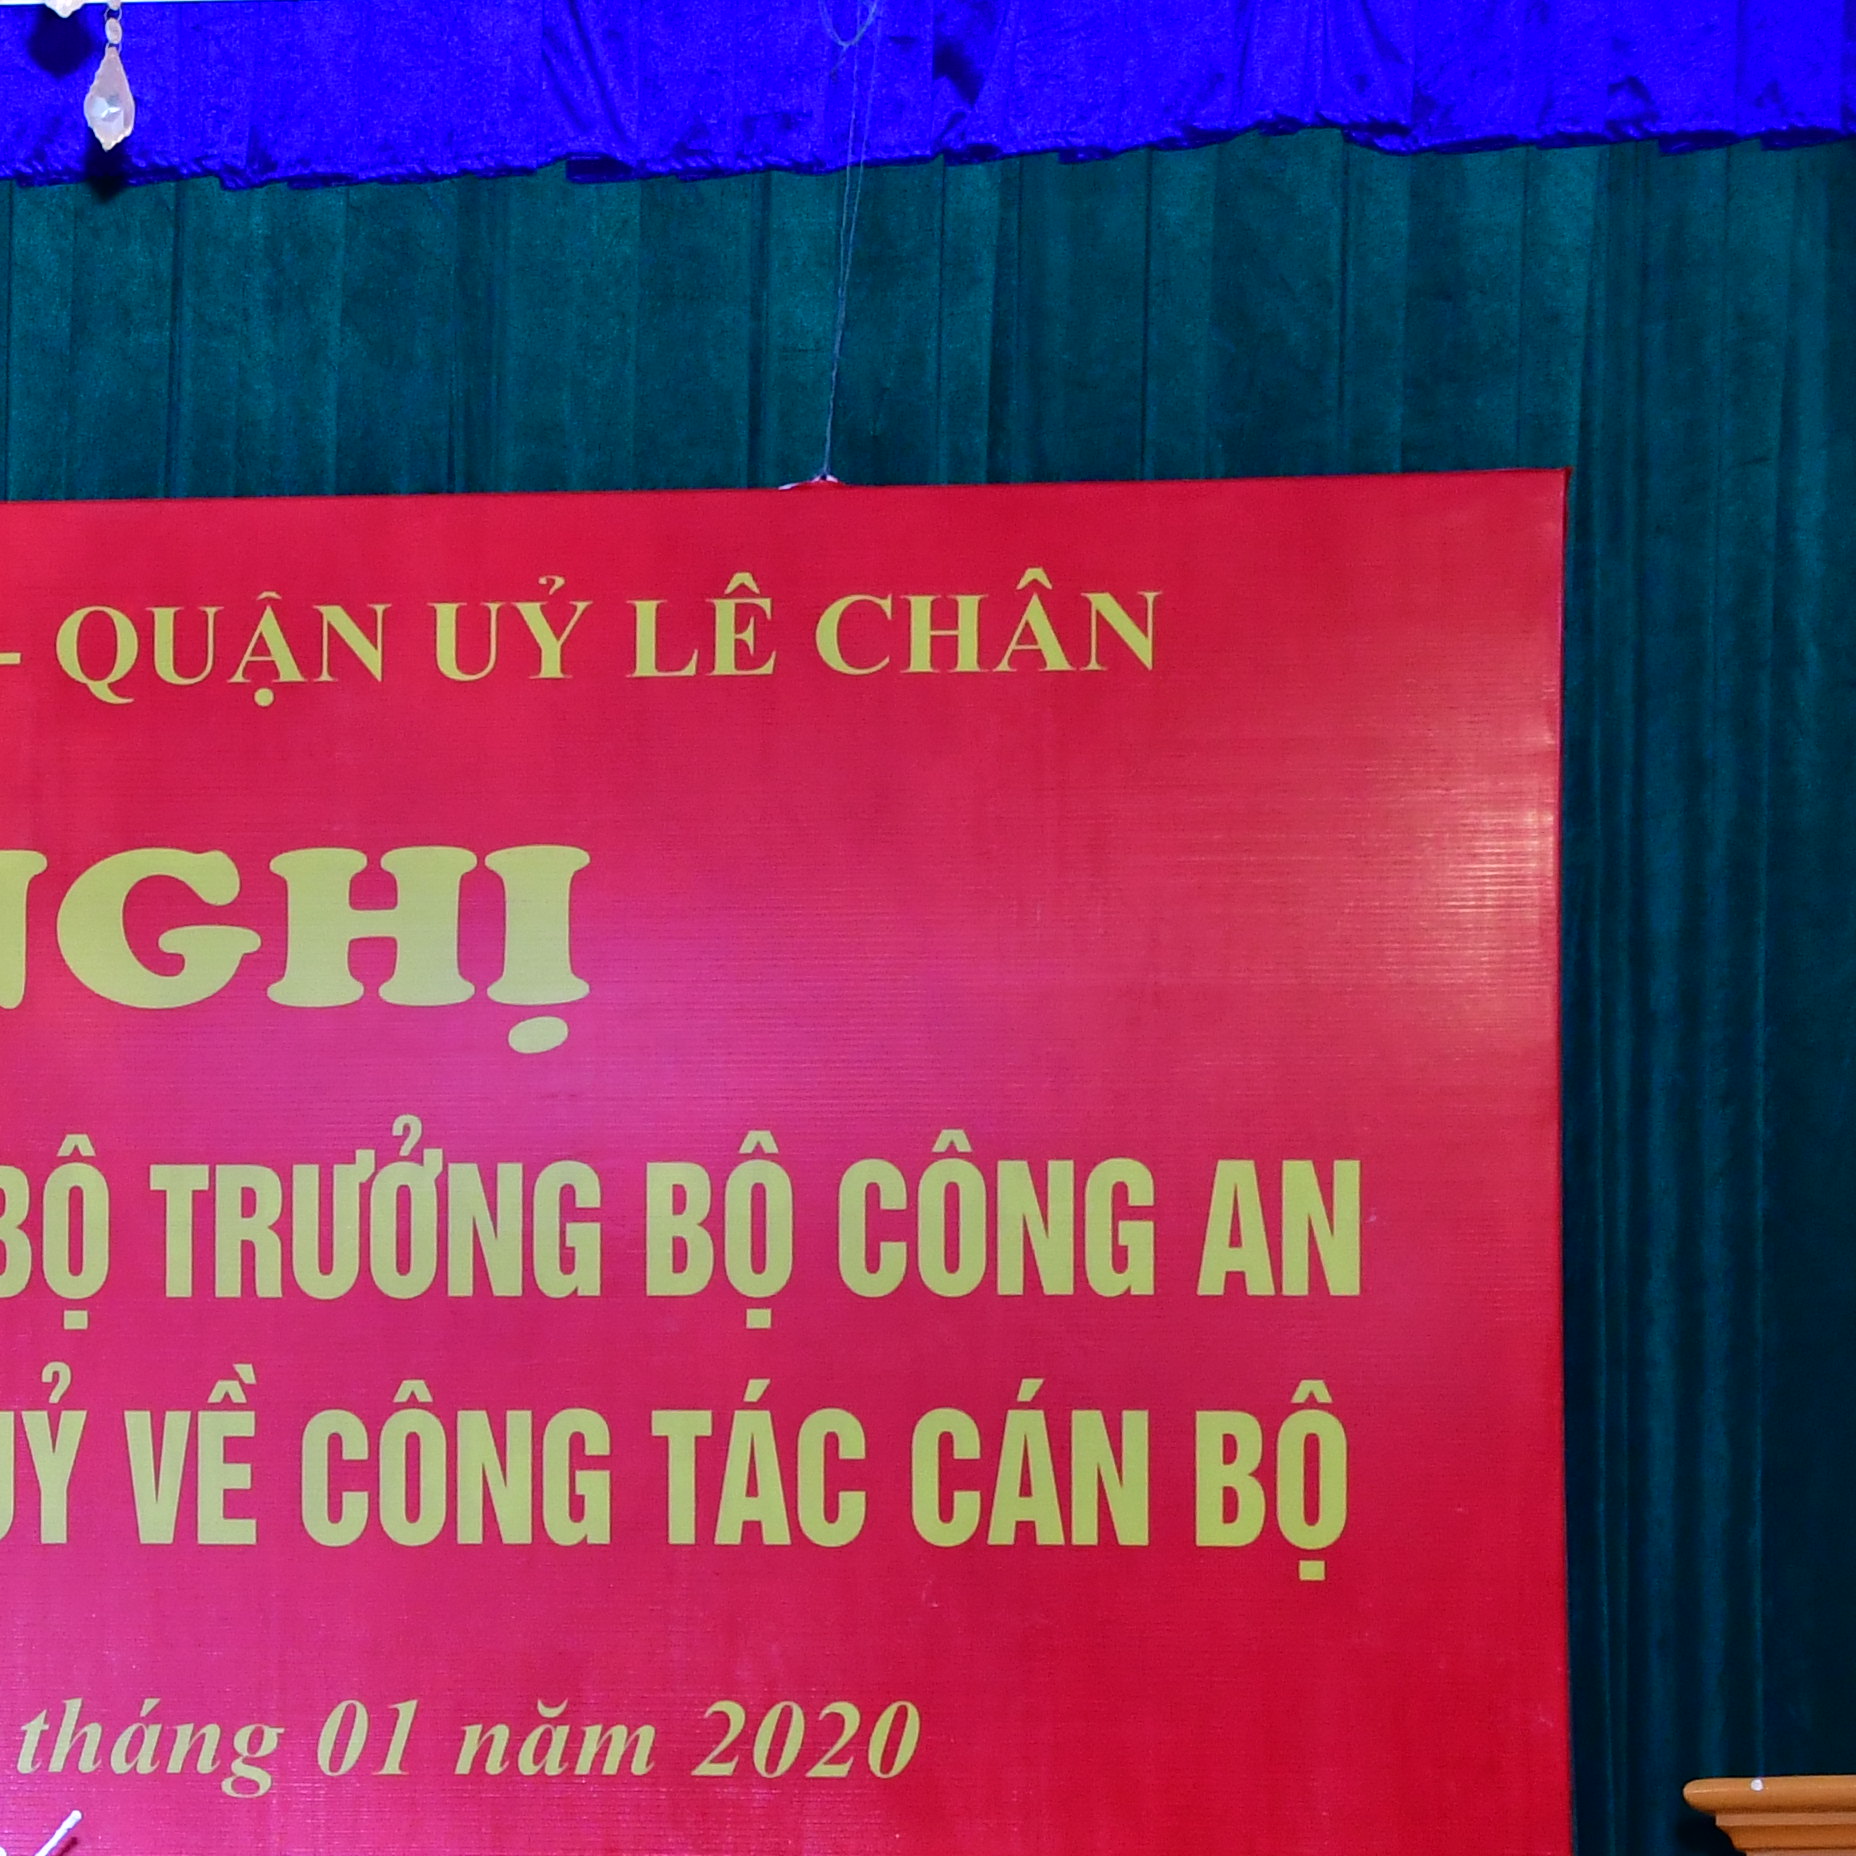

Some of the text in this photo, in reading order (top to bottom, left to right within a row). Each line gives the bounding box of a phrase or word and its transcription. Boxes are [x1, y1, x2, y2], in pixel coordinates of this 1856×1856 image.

[55, 590, 386, 706] QUẬN
[433, 575, 591, 682] UỶ
[628, 573, 776, 678] LÊ
[816, 568, 1164, 675] CHÂN
[148, 1114, 602, 1301] TRƯỞNG
[645, 1130, 794, 1329] BỘ
[837, 1129, 1156, 1298] CÔNG
[1196, 1158, 1361, 1297] AN
[123, 1362, 258, 1546] VỀ
[300, 1379, 612, 1548] CÔNG
[651, 1378, 867, 1548] TÁC
[911, 1378, 1150, 1548] CÁN
[1194, 1379, 1348, 1581] BỘ
[16, 1697, 285, 1799] tháng
[316, 1699, 418, 1778] 01
[455, 1702, 656, 1777] năm
[692, 1700, 921, 1778] 2020
